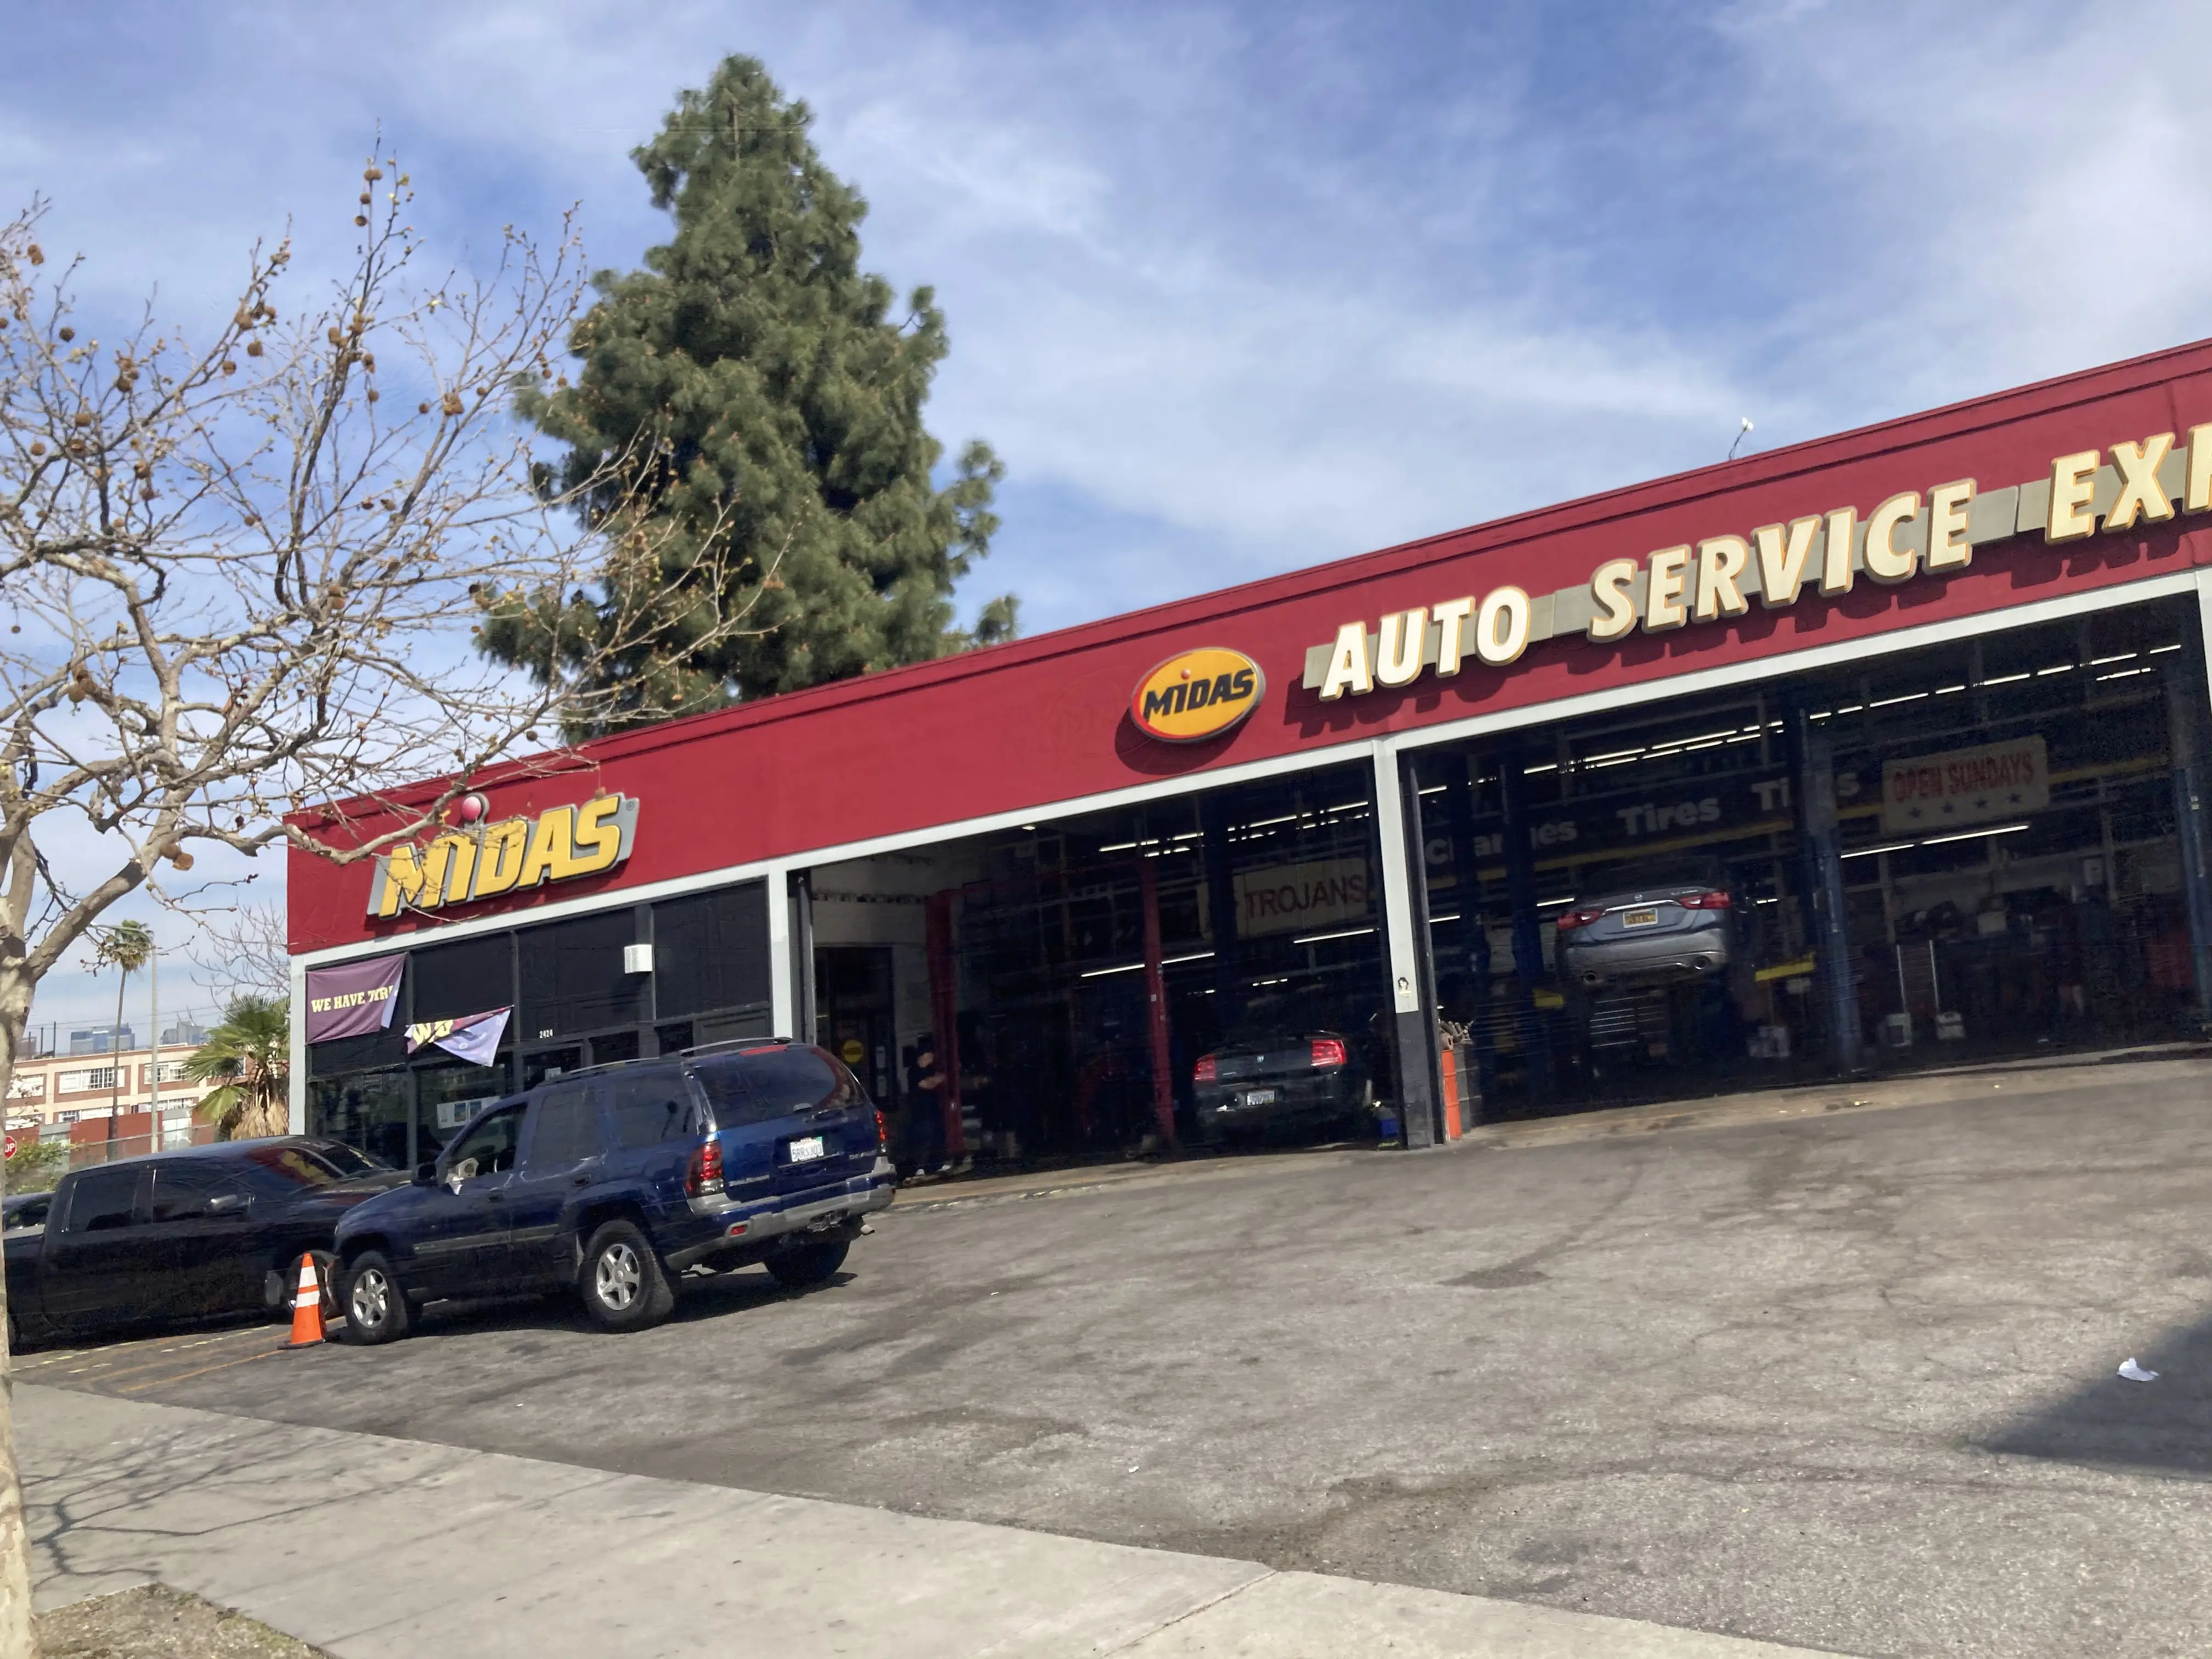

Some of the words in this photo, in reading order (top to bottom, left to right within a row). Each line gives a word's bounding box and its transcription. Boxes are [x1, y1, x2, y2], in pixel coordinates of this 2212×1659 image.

[1322, 587, 1530, 698] AUTO
[1590, 479, 1976, 639] SERVICE
[1143, 668, 1254, 723] MIDAS
[1893, 767, 1943, 802] OPEN
[1947, 750, 2034, 794] SUNDAYS
[1616, 797, 1721, 836] Tires
[379, 795, 620, 917] MIDAS
[1245, 874, 1366, 917] TROJANS
[311, 998, 331, 1013] WE
[334, 992, 365, 1009] HAVE
[540, 1029, 553, 1039] 2424
